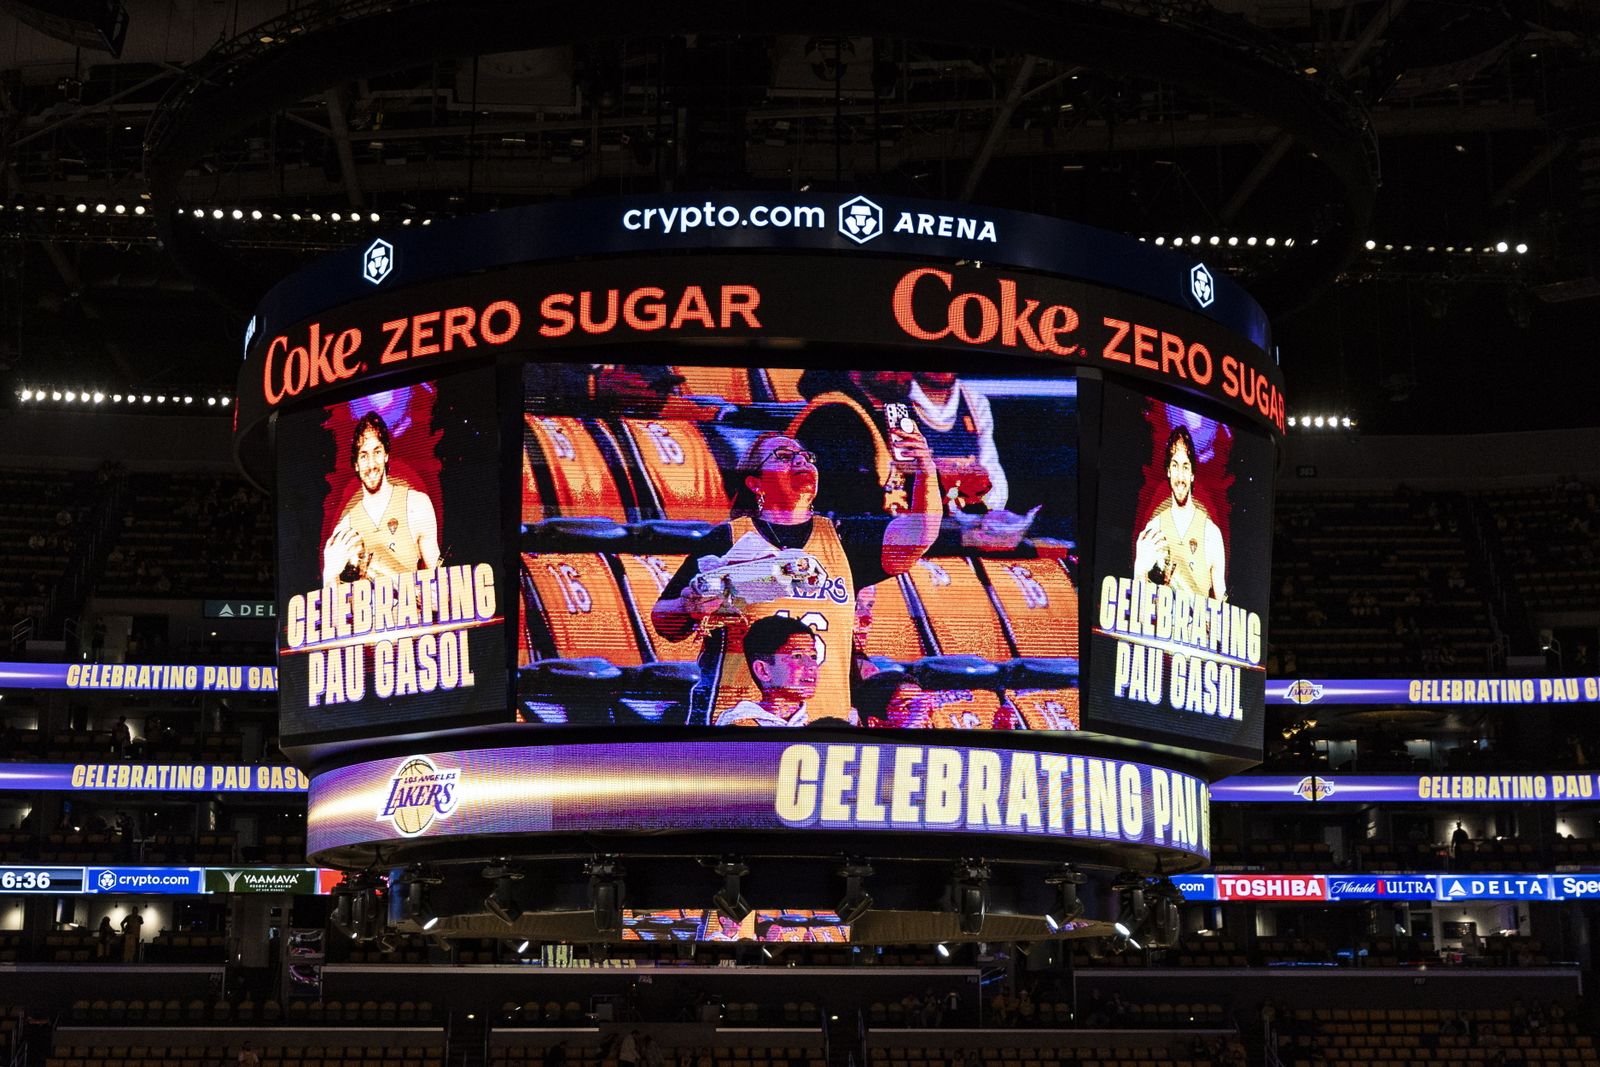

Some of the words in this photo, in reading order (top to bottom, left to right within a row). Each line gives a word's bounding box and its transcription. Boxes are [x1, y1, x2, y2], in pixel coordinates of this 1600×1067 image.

[622, 201, 825, 233] crypto.com
[893, 211, 998, 243] ARENA
[263, 323, 363, 405] Coke
[380, 300, 521, 365] ZERO
[538, 284, 763, 338] SUGAR
[891, 266, 1080, 357] Coke
[1102, 316, 1214, 386] ZERO
[1221, 354, 1287, 436] SUGAR
[547, 562, 593, 614] 16
[287, 563, 497, 649] CELEBRATING
[1099, 575, 1262, 665] CELEBRATING
[66, 664, 198, 690] CELEBRATING
[203, 666, 243, 690] PAU
[248, 667, 278, 691] GA
[308, 643, 366, 707] PAU
[374, 630, 475, 699] GASOL
[1114, 640, 1164, 705] PAU
[1170, 652, 1244, 721] GASOL
[1408, 679, 1535, 703] CELEBRATING
[1540, 678, 1580, 702] PAU
[71, 764, 206, 790] CELEBRATING
[211, 765, 251, 790] PAU
[404, 776, 418, 784] LOS
[418, 773, 457, 783] ANGELES
[1418, 776, 1547, 799] CELEBRATING
[1552, 775, 1593, 798] PAU
[380, 778, 458, 816] LAKERS
[774, 743, 1143, 844] CELEBRATING
[1151, 768, 1198, 850] PAU
[118, 874, 189, 887] crypto.com
[1221, 879, 1322, 897] TOSHIBA
[1330, 881, 1375, 893] Michelob
[1386, 881, 1435, 894] ULTRA
[1471, 881, 1544, 895] DELTA
[1562, 877, 1600, 897] Spe
